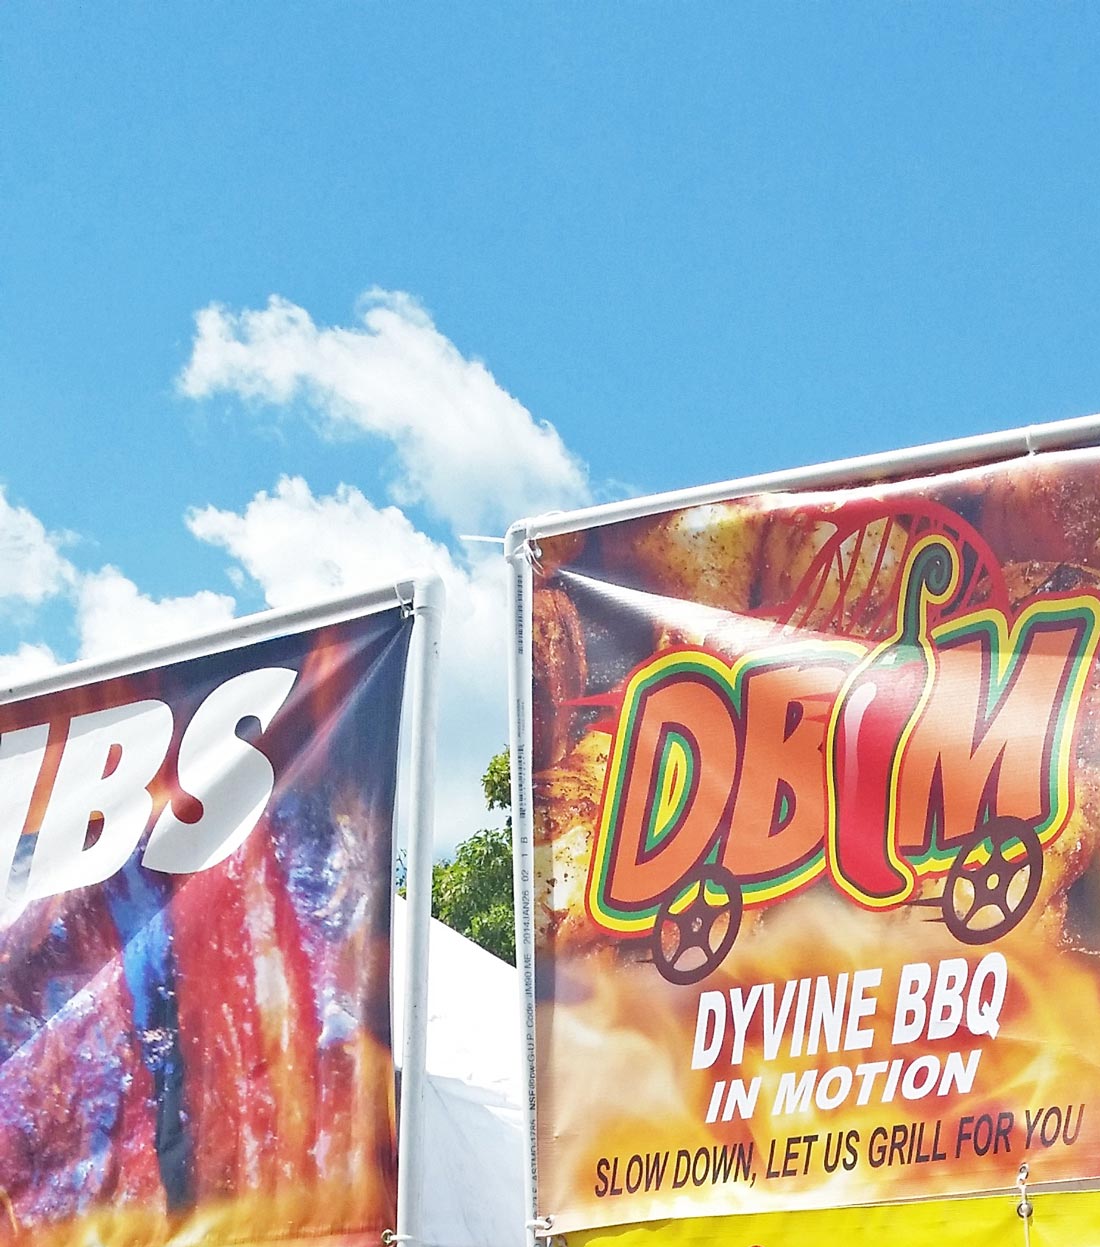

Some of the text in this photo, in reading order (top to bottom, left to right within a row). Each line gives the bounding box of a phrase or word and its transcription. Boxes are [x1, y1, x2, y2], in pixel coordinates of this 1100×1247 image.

[526, 1003, 534, 1028] Code
[691, 952, 1008, 1069] DYVINE BBQ
[705, 1049, 981, 1124] IN MOTION
[593, 1103, 1087, 1199] SLOW DOWN, LET US GRILL FOR YOU
